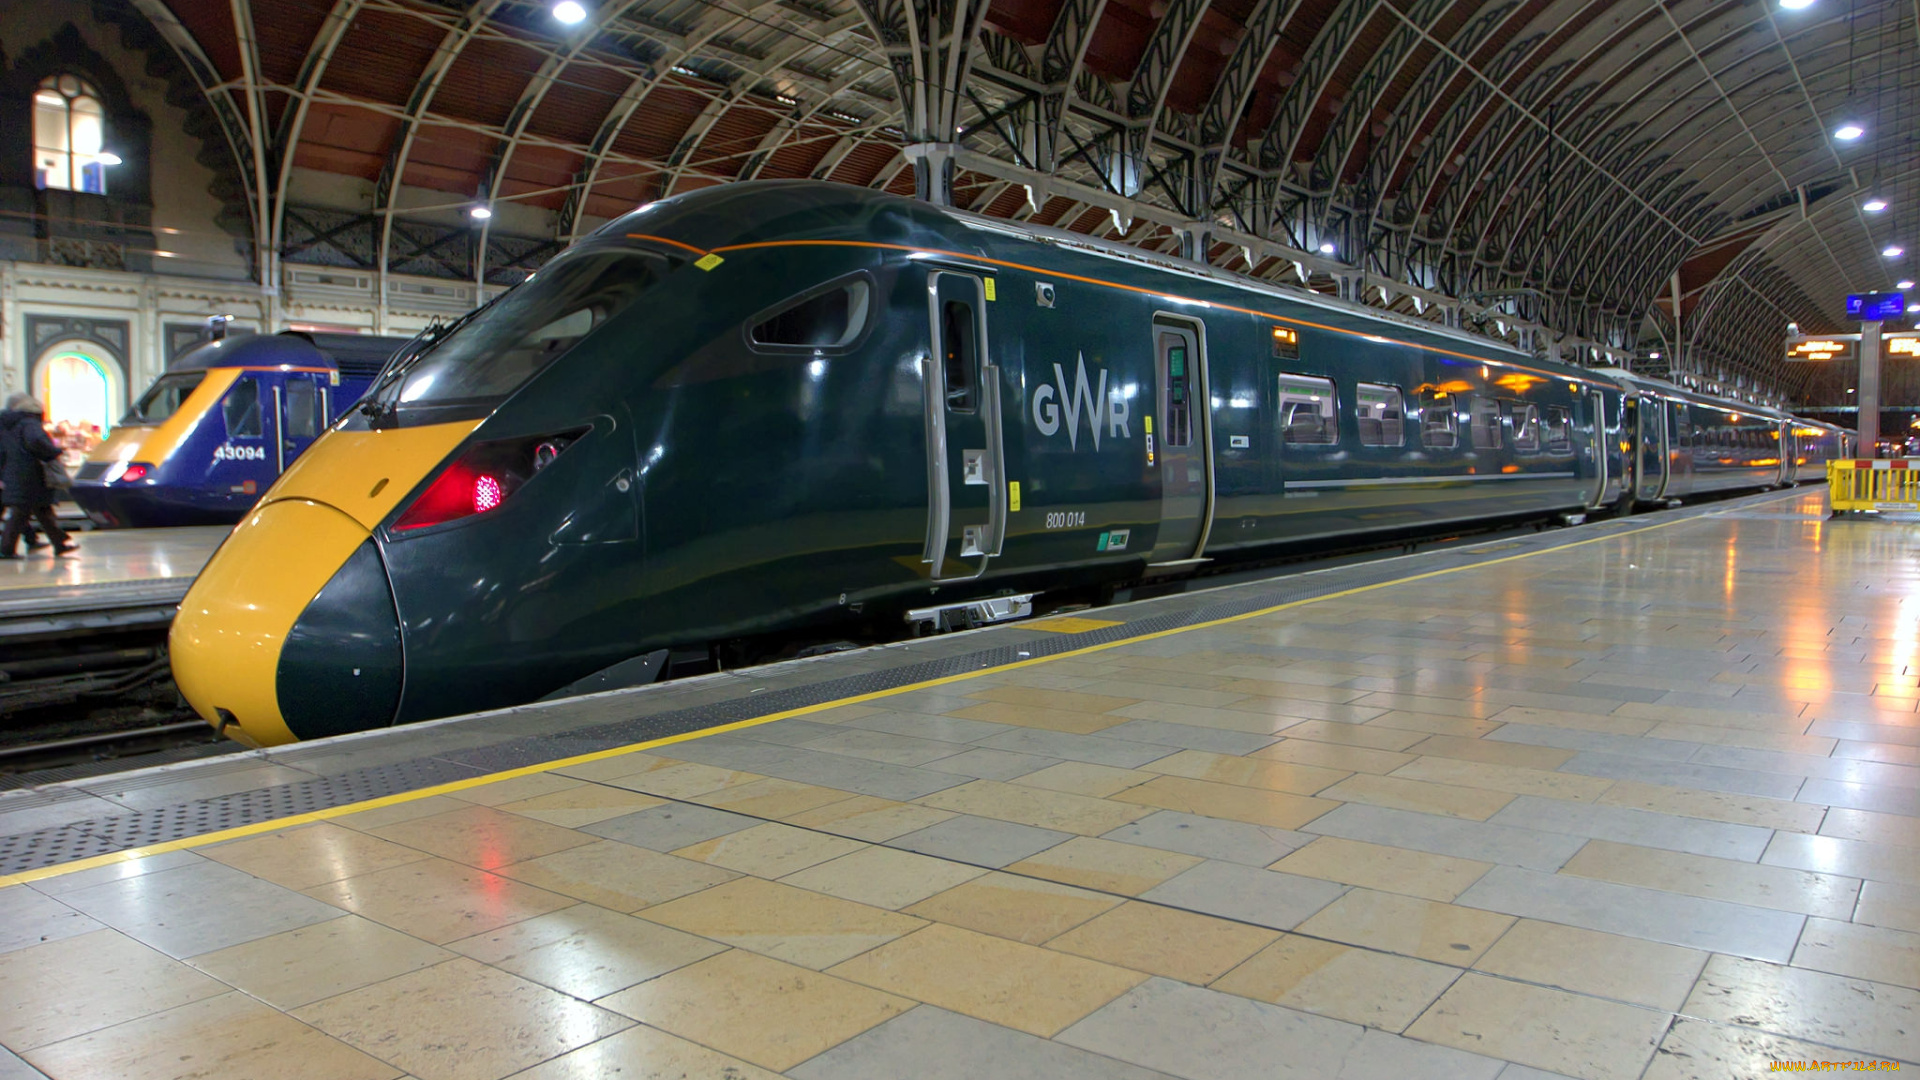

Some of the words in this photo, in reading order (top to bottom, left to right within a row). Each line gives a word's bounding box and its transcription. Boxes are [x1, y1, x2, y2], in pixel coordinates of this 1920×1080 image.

[1032, 349, 1131, 453] GWR
[213, 445, 265, 460] 43094
[1046, 511, 1065, 529] 800
[1067, 511, 1085, 527] 014
